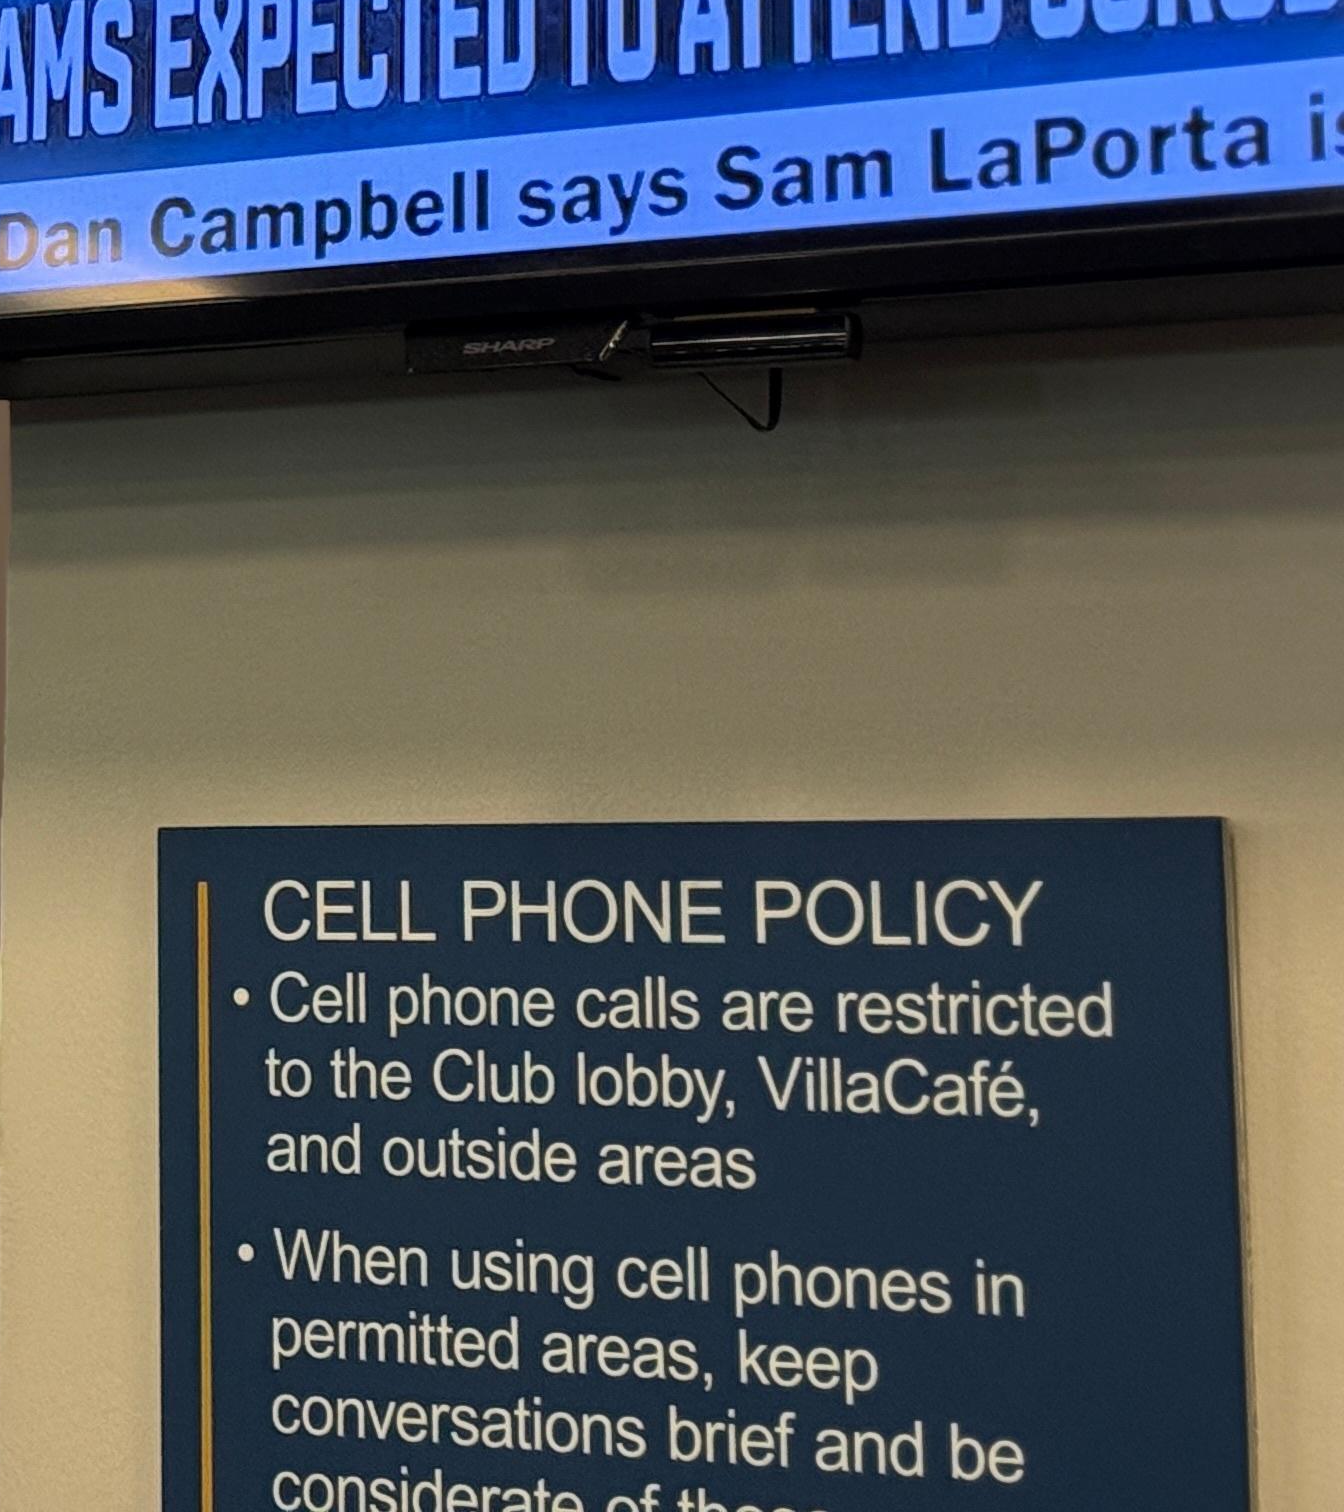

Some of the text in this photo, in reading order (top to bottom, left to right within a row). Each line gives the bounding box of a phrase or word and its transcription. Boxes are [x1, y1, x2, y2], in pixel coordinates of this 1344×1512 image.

[150, 168, 489, 260] Campbell
[517, 167, 688, 237] says
[714, 144, 894, 211] Sam
[930, 106, 1271, 193] LaPorta
[1309, 91, 1344, 163] i
[463, 337, 556, 355] SHARP
[264, 879, 1044, 947] CELL PHONE POLICY
[270, 970, 1113, 1038] Cell phone calls are restricted
[264, 1046, 1039, 1127] to the Club lobby, VillaCafé,
[266, 1122, 757, 1190] and outside areas
[273, 1227, 1025, 1318] When using cell phones in
[272, 1310, 879, 1406] permitted areas, keep
[272, 1393, 1025, 1484] conversations brief and be
